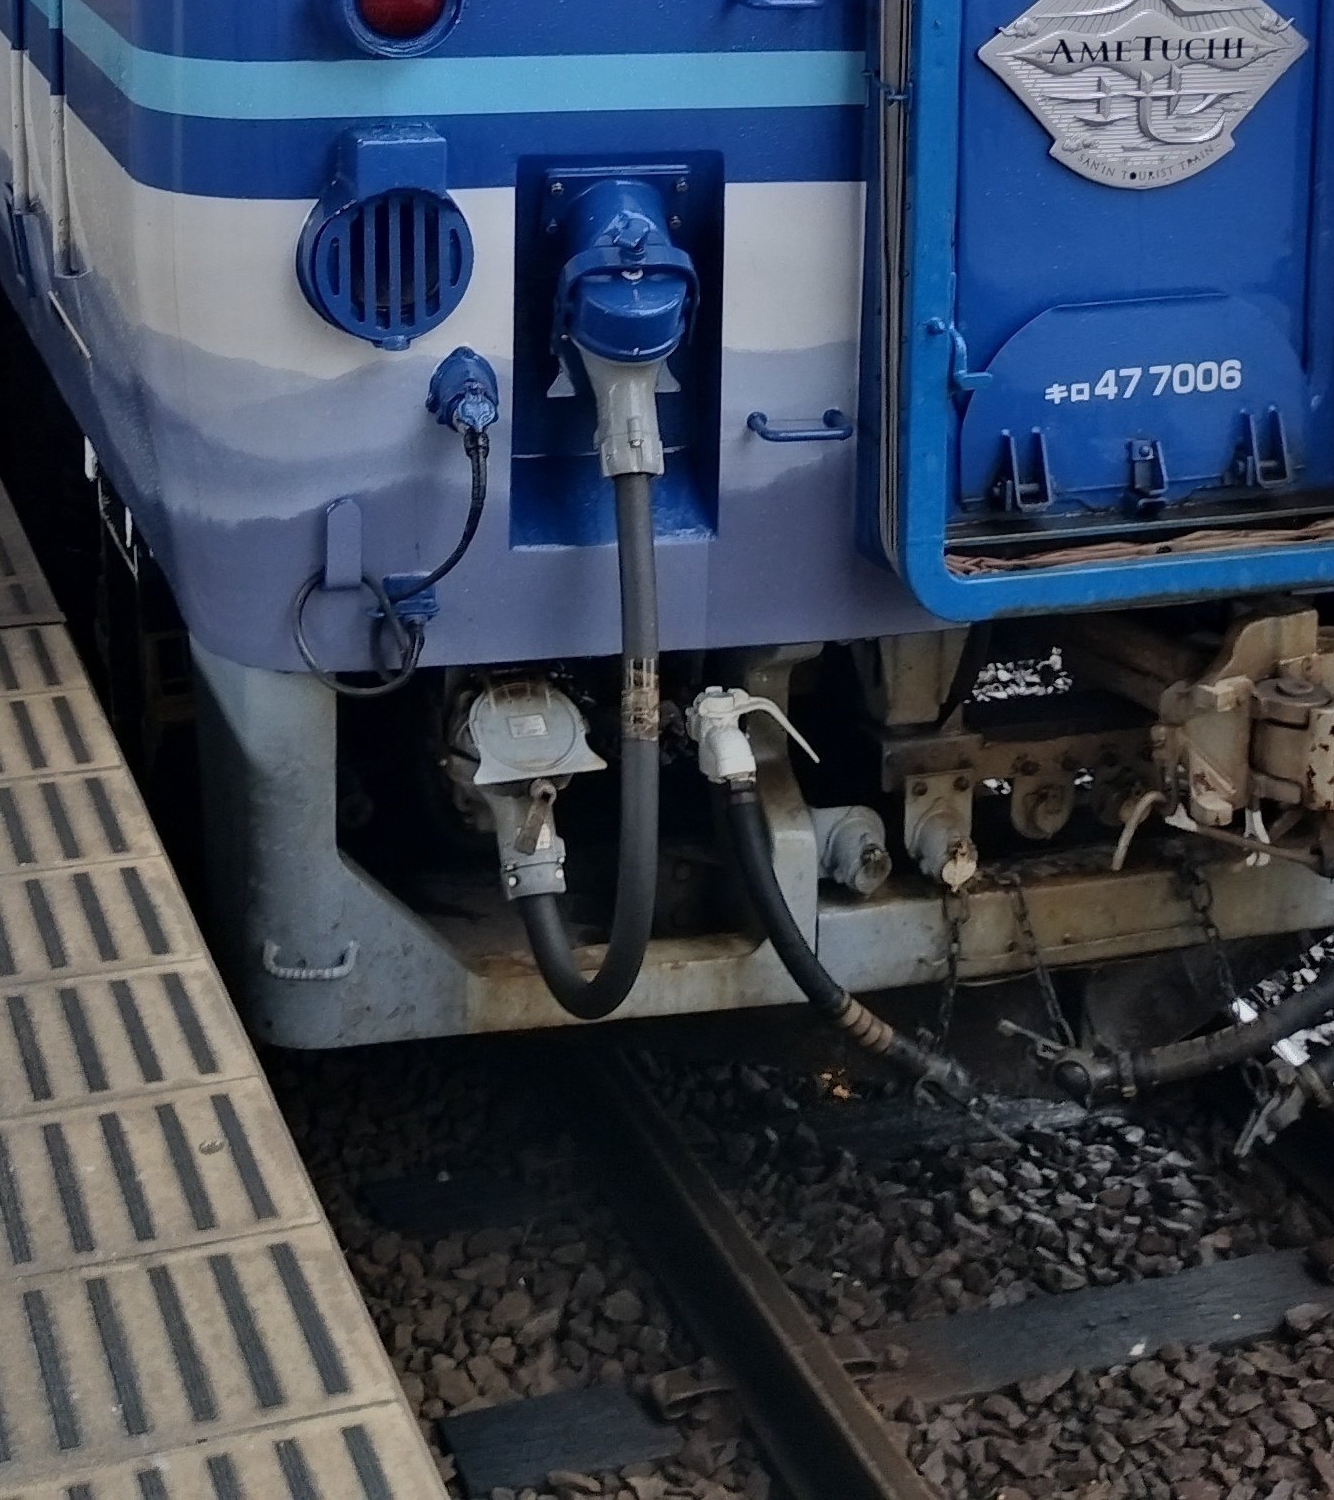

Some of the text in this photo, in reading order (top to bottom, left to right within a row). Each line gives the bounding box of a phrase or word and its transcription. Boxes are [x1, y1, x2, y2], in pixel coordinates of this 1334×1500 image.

[1049, 36, 1245, 64] AMETUCHI
[1180, 144, 1215, 170] TRAIN
[1149, 359, 1242, 396] 7006
